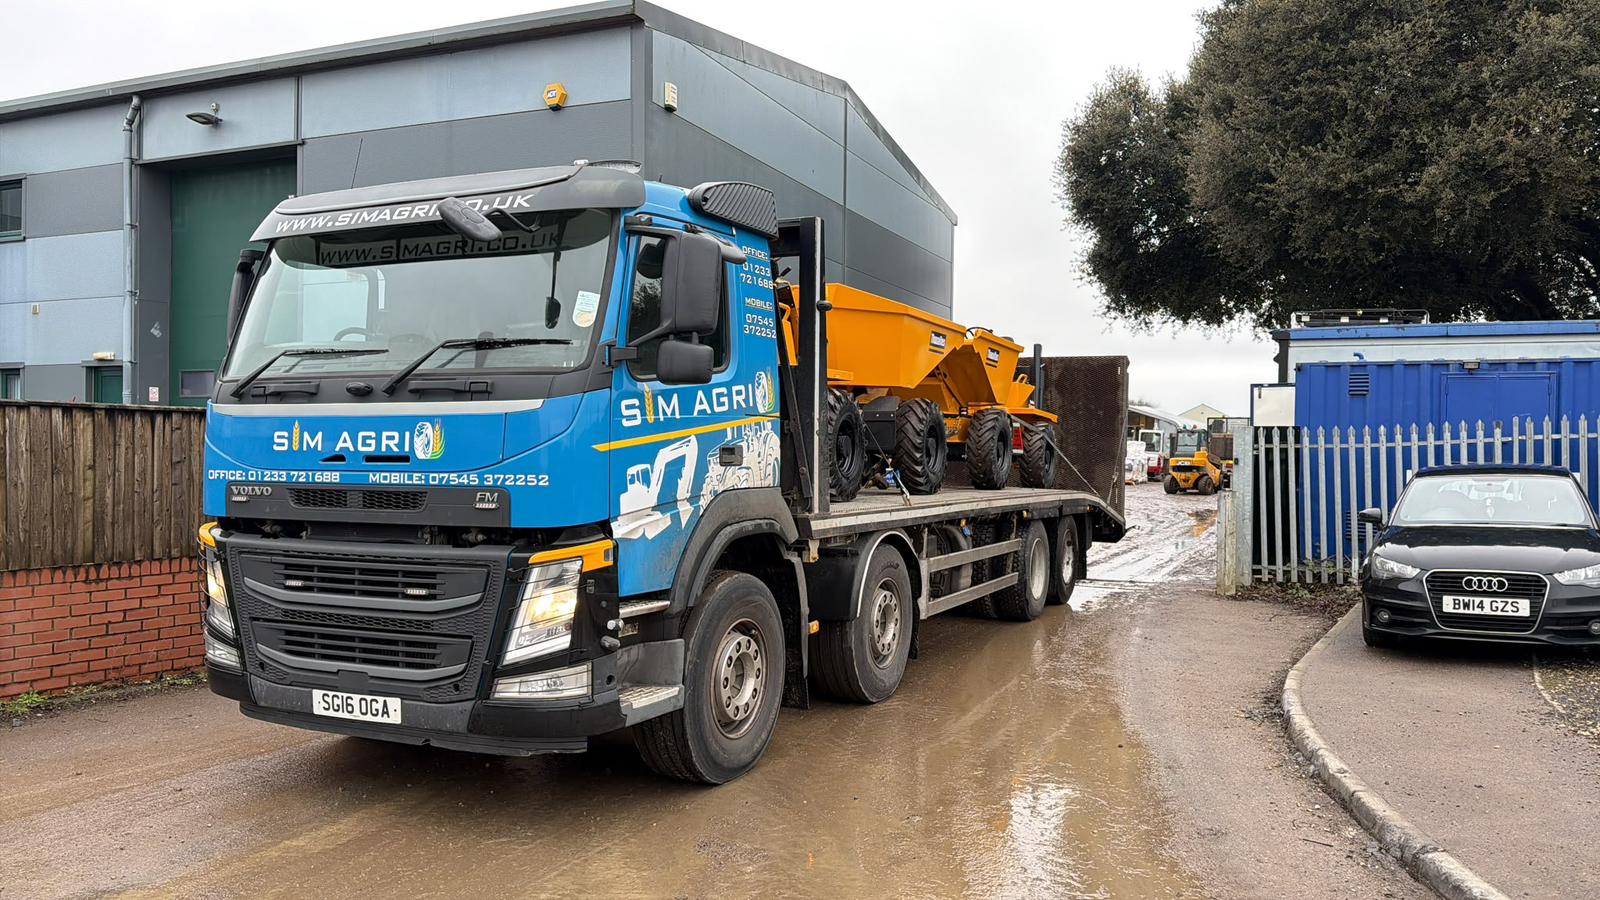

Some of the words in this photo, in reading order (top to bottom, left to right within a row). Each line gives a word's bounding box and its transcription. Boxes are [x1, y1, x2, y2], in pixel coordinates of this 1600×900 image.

[275, 194, 534, 233] WWW.SIMAGRI.O.UK
[742, 246, 768, 260] OFFICE:
[742, 263, 771, 277] 01233
[740, 273, 774, 290] 721688
[745, 297, 773, 310] MOBILE:
[745, 313, 774, 328] 07545
[743, 324, 777, 339] 372252
[620, 385, 681, 428] SIM
[693, 383, 753, 416] AGRI
[273, 421, 323, 452] SIM
[335, 431, 410, 452] AGRI
[208, 469, 246, 480] OFFICE:
[248, 471, 286, 482] 01233
[290, 472, 340, 483] 721688
[369, 472, 425, 484] MOBILE:
[429, 473, 479, 485] 07545
[484, 474, 549, 486] 372252
[230, 485, 272, 496] VOLVO
[475, 492, 498, 502] FM
[1452, 598, 1485, 612] BW14
[1490, 600, 1520, 613] GZS
[322, 693, 354, 714] SG16
[359, 697, 390, 719] OGA
